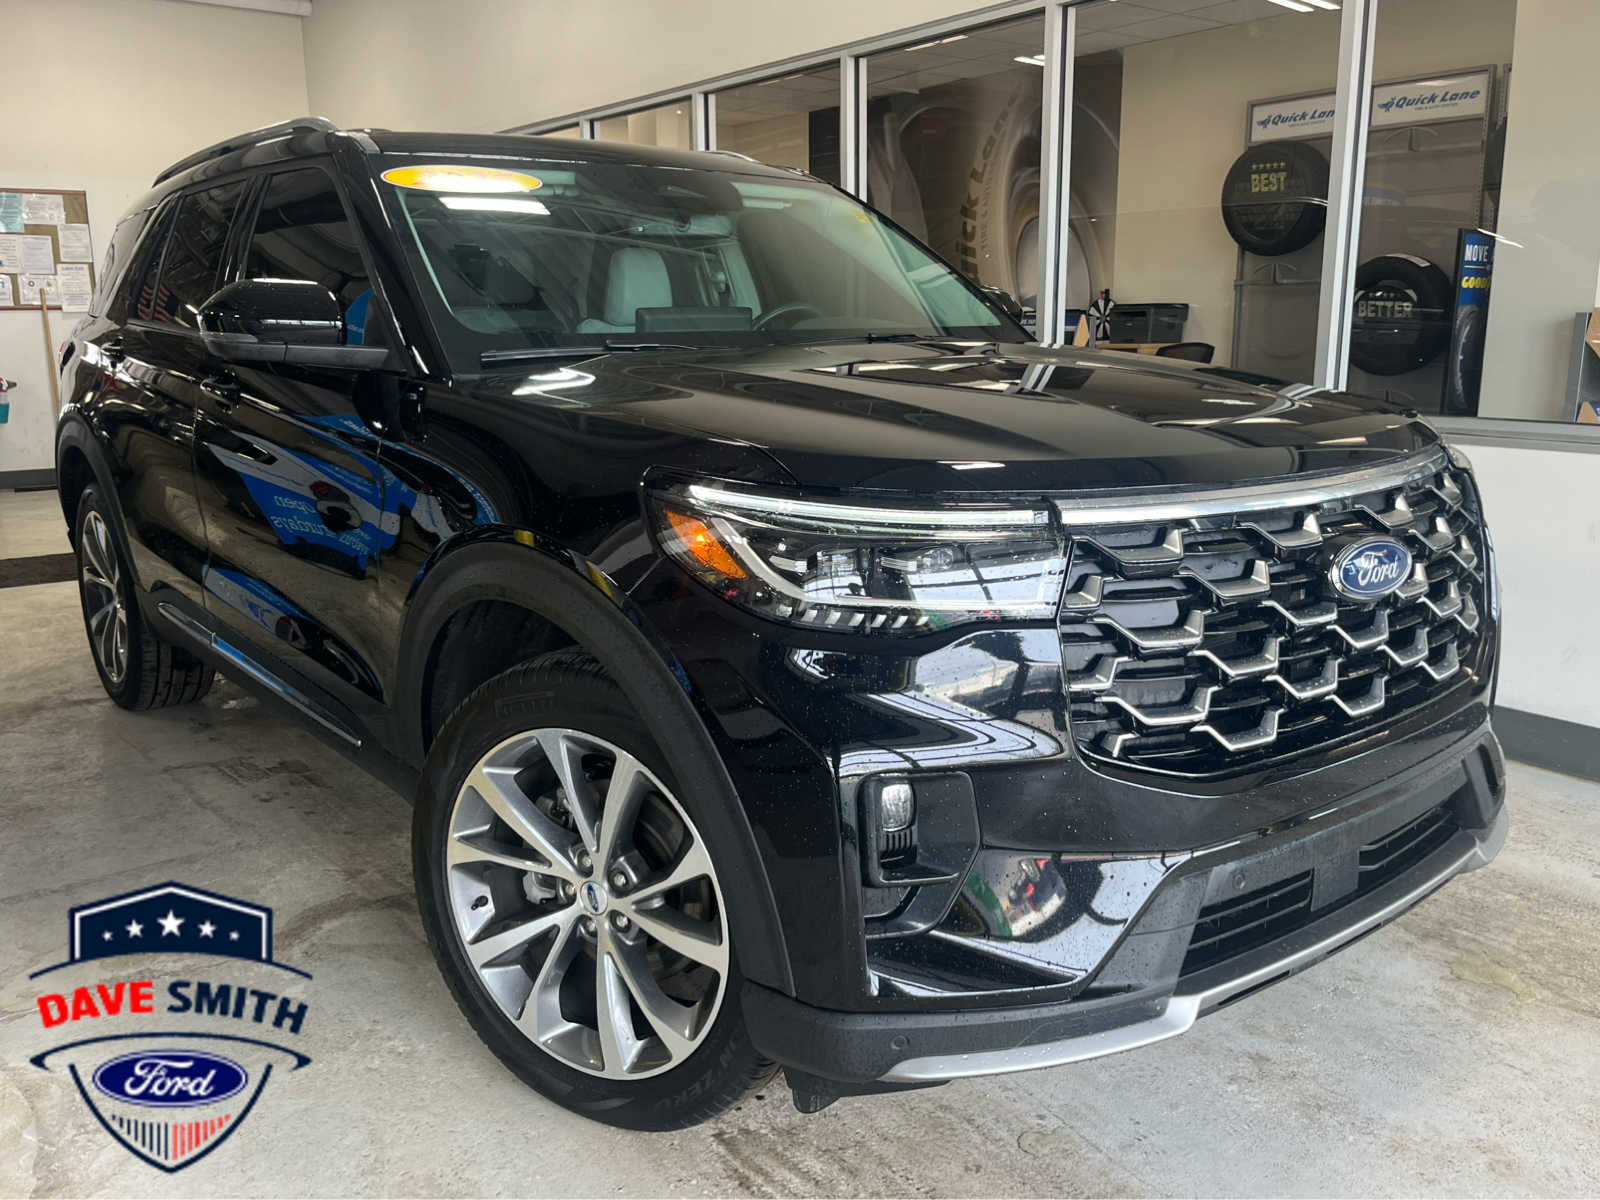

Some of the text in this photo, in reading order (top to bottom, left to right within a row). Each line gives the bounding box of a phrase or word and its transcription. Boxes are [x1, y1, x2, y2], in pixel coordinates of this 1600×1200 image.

[1395, 92, 1438, 109] Quick
[1441, 89, 1480, 102] Lane
[1271, 111, 1308, 126] Quick
[1310, 108, 1335, 120] Lan
[1250, 171, 1287, 192] BEST
[955, 192, 981, 287] uick
[1465, 244, 1489, 262] MOVE
[1358, 300, 1413, 318] BETTER
[1357, 549, 1399, 586] Ford
